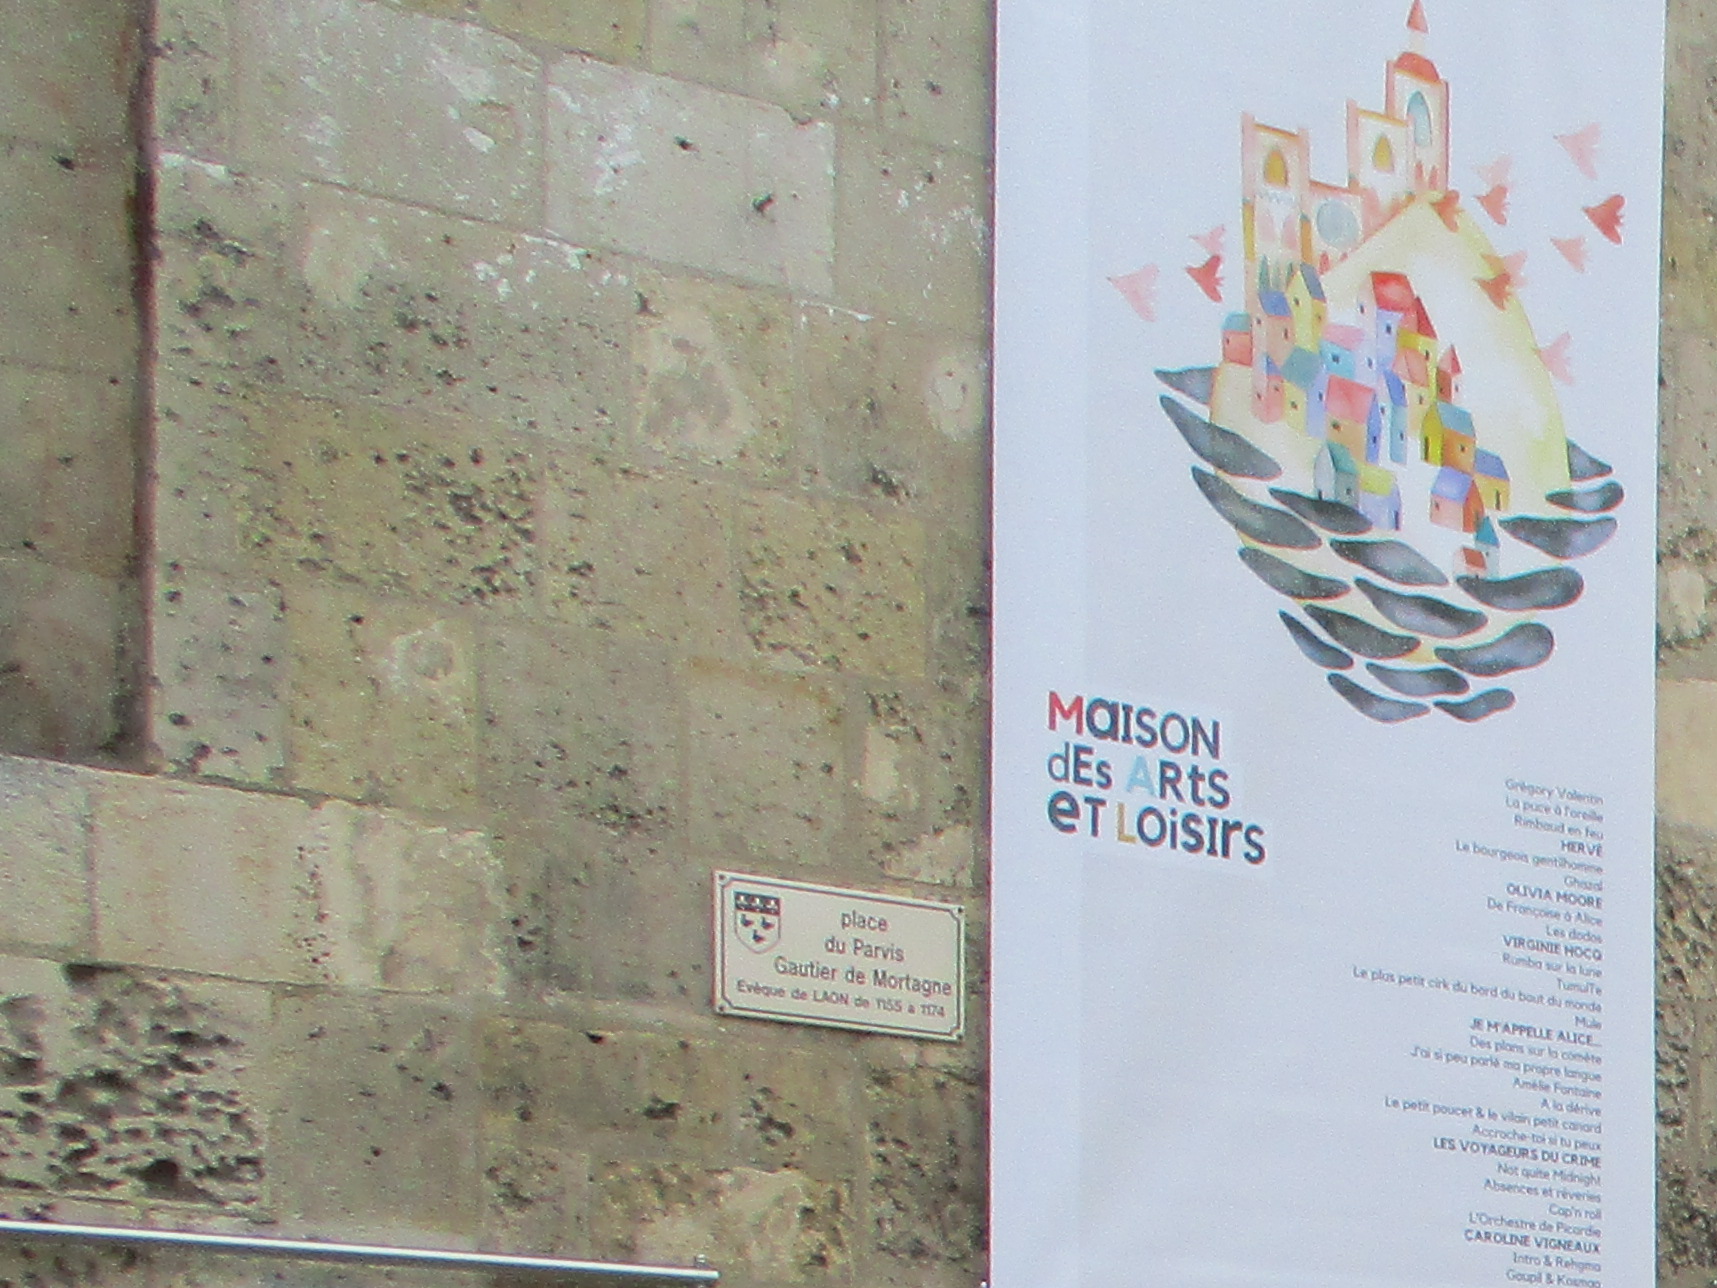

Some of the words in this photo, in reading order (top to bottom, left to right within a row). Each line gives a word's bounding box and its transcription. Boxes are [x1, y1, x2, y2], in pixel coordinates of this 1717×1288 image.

[1507, 882, 1552, 901] OLIVIA
[1556, 890, 1602, 909] MOORE
[841, 909, 888, 932] place
[824, 936, 846, 954] du
[853, 938, 905, 962] Parvis
[1503, 934, 1560, 955] VIRGINIE
[774, 955, 836, 981] Gautier
[845, 966, 866, 984] de
[873, 968, 952, 998] Mortagne
[1475, 1107, 1483, 1118] &
[1433, 1137, 1455, 1150] LES
[1459, 1140, 1538, 1161] VOYAGEURS
[1541, 1150, 1558, 1163] DU
[1561, 1152, 1601, 1168] CRIME
[1464, 1228, 1530, 1247] CAROLINE
[1534, 1236, 1600, 1254] VIGNEAUX
